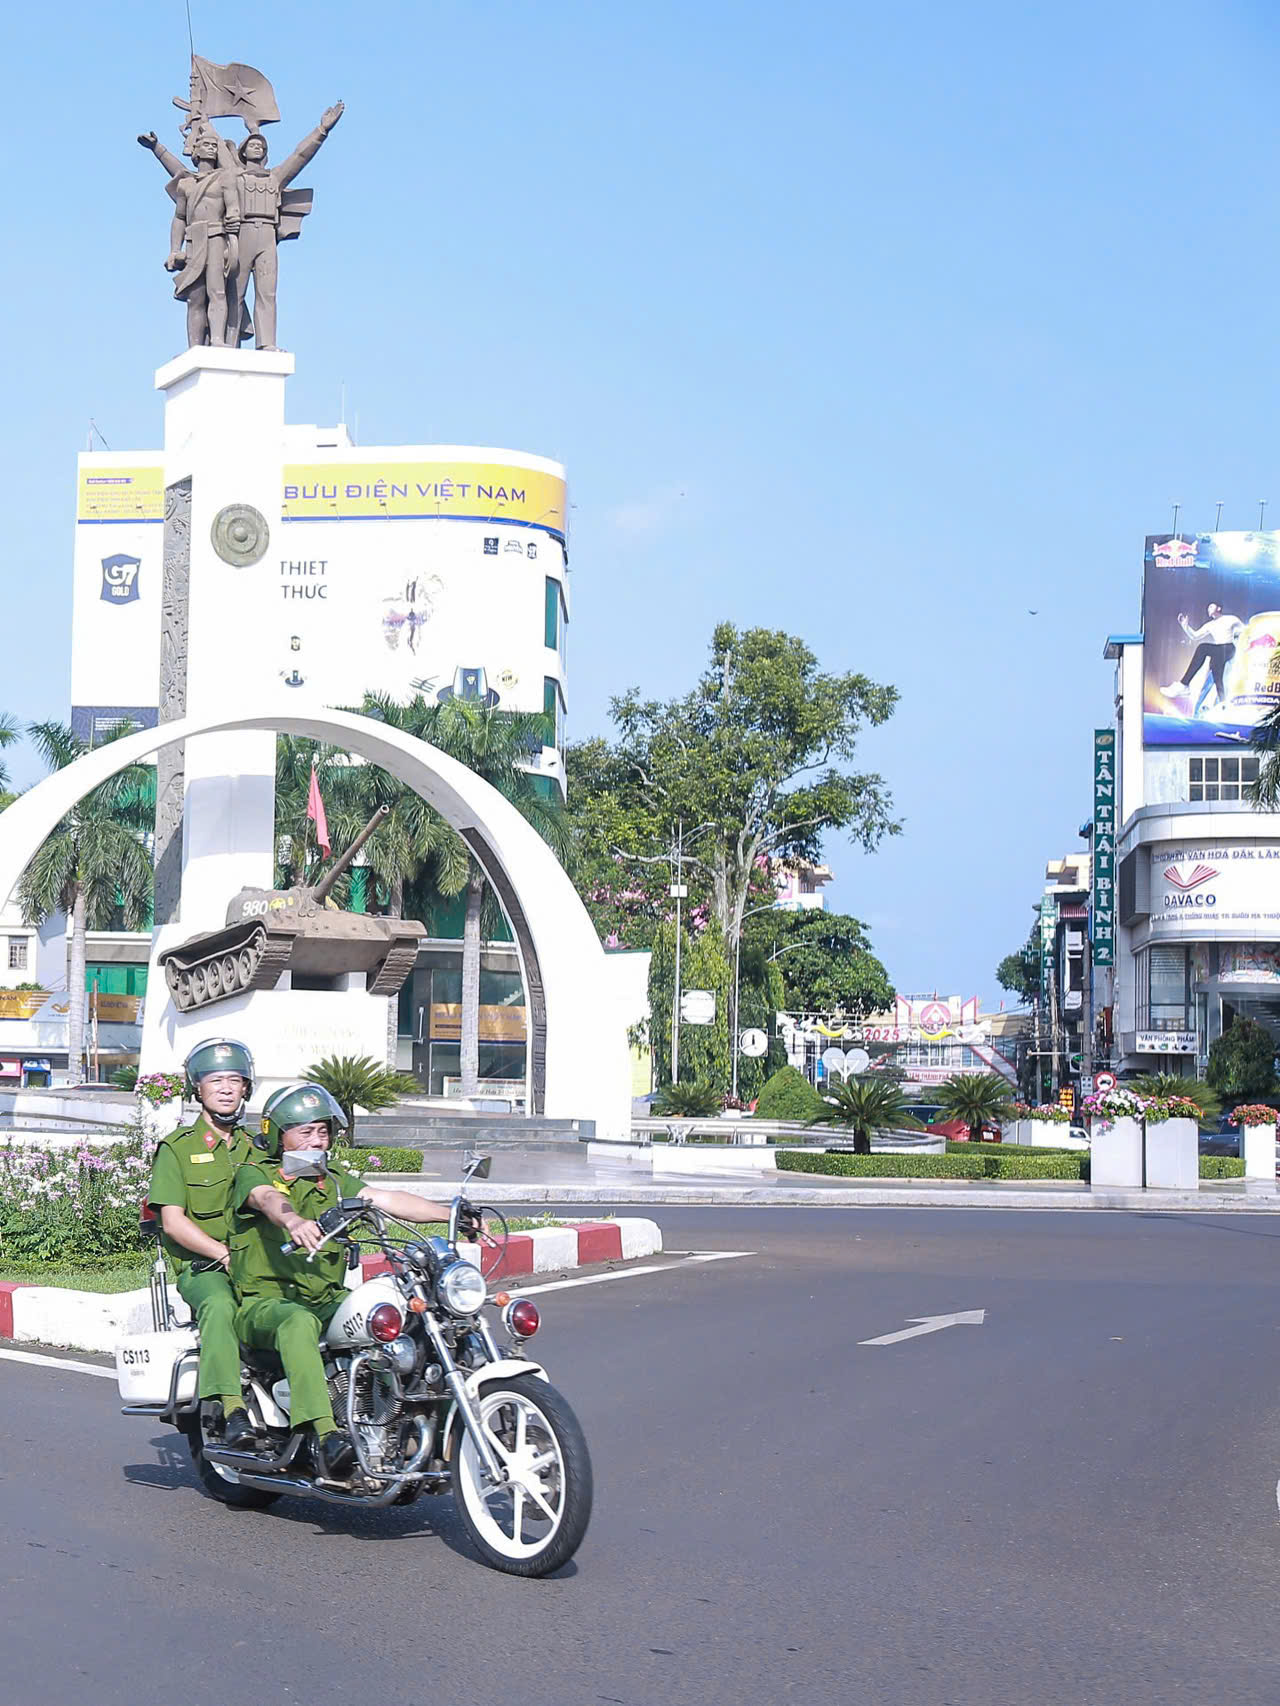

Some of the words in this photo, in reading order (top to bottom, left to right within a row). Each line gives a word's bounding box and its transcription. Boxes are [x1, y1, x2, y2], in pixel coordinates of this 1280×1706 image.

[284, 483, 337, 499] BƯU
[345, 479, 408, 503] ĐIỆN
[416, 478, 471, 502] VIỆT
[477, 485, 526, 503] NAM
[1156, 557, 1174, 567] Red
[1175, 557, 1193, 567] Bull
[104, 563, 140, 586] G7
[111, 586, 130, 597] GOLD
[1096, 750, 1113, 797] TÂN
[1096, 805, 1113, 868] THÁI
[242, 900, 268, 916] 980
[1096, 877, 1113, 939] BÌNH
[1164, 894, 1216, 906] DAVACO
[1098, 947, 1111, 959] 2
[864, 1027, 900, 1041] 2025
[343, 1312, 363, 1338] CS113
[123, 1349, 150, 1364] CS113
